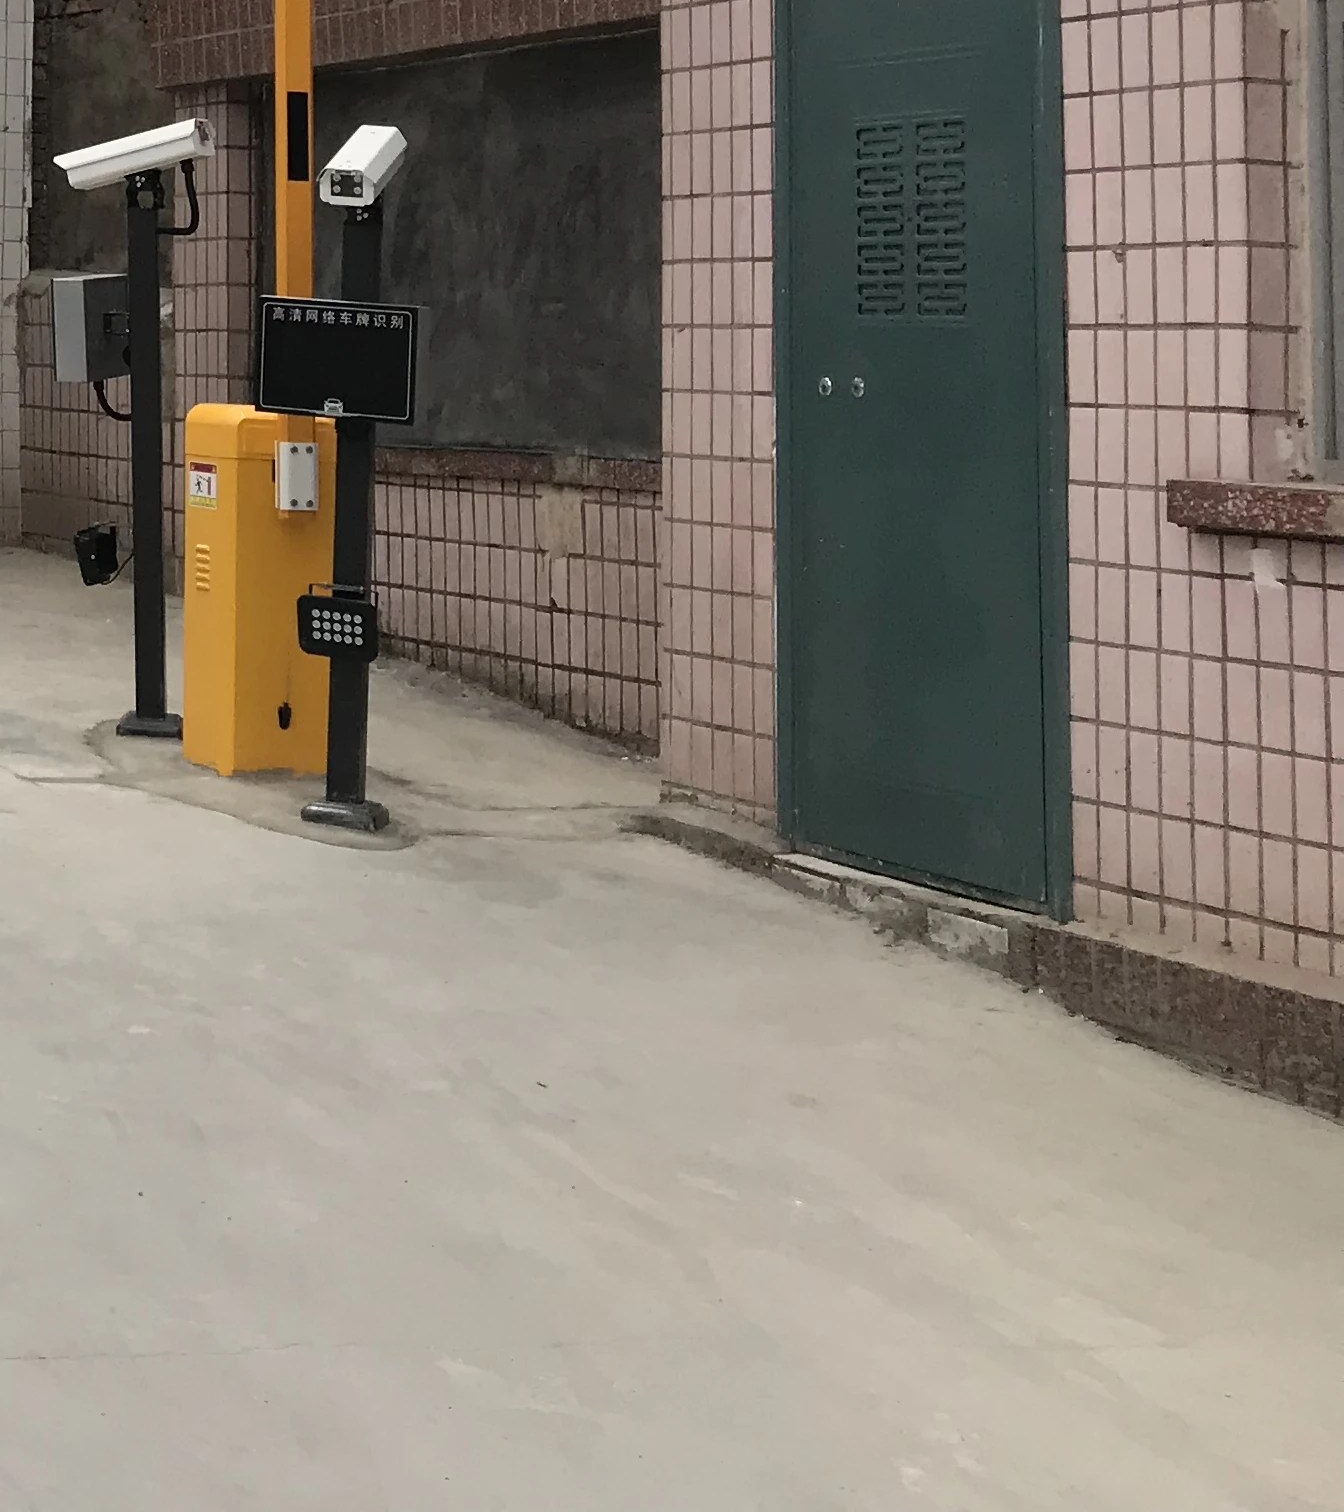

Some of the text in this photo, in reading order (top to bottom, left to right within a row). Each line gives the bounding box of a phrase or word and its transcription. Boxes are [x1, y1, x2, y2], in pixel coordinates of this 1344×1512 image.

[272, 305, 404, 330] 高清网络车牌识别
